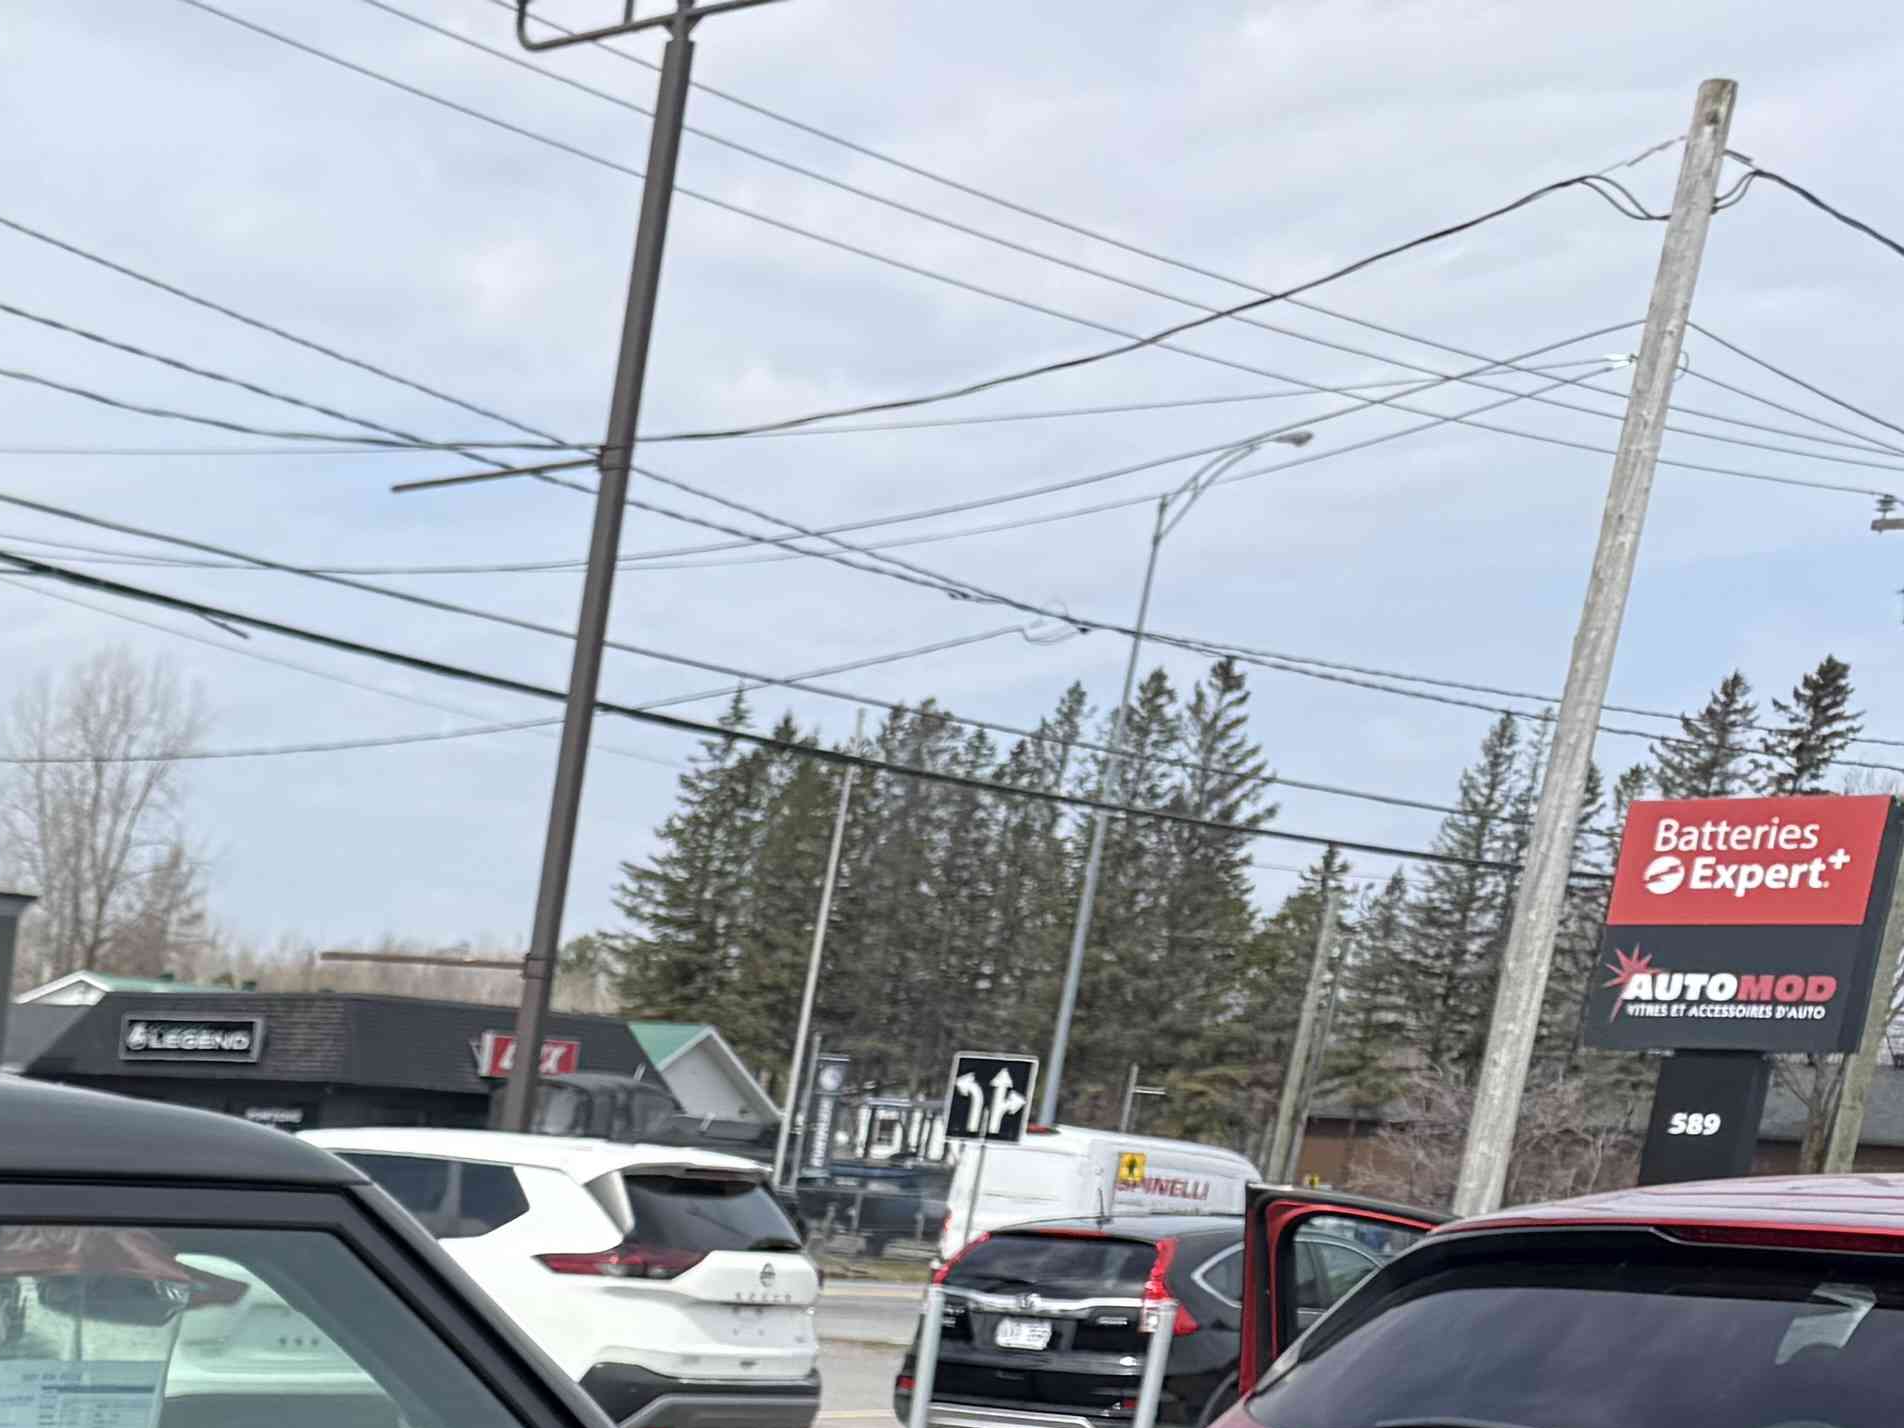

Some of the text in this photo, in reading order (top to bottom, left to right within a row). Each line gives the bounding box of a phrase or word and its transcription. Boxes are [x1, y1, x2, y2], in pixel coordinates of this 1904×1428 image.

[1653, 815, 1821, 852] Batteries
[1623, 972, 1838, 1003] AUTOMOD
[1670, 1003, 1686, 1017] ET
[1687, 1003, 1773, 1019] ACCESSOIRES
[1774, 1005, 1826, 1020] D'AUTO
[148, 1027, 250, 1050] LEGEND
